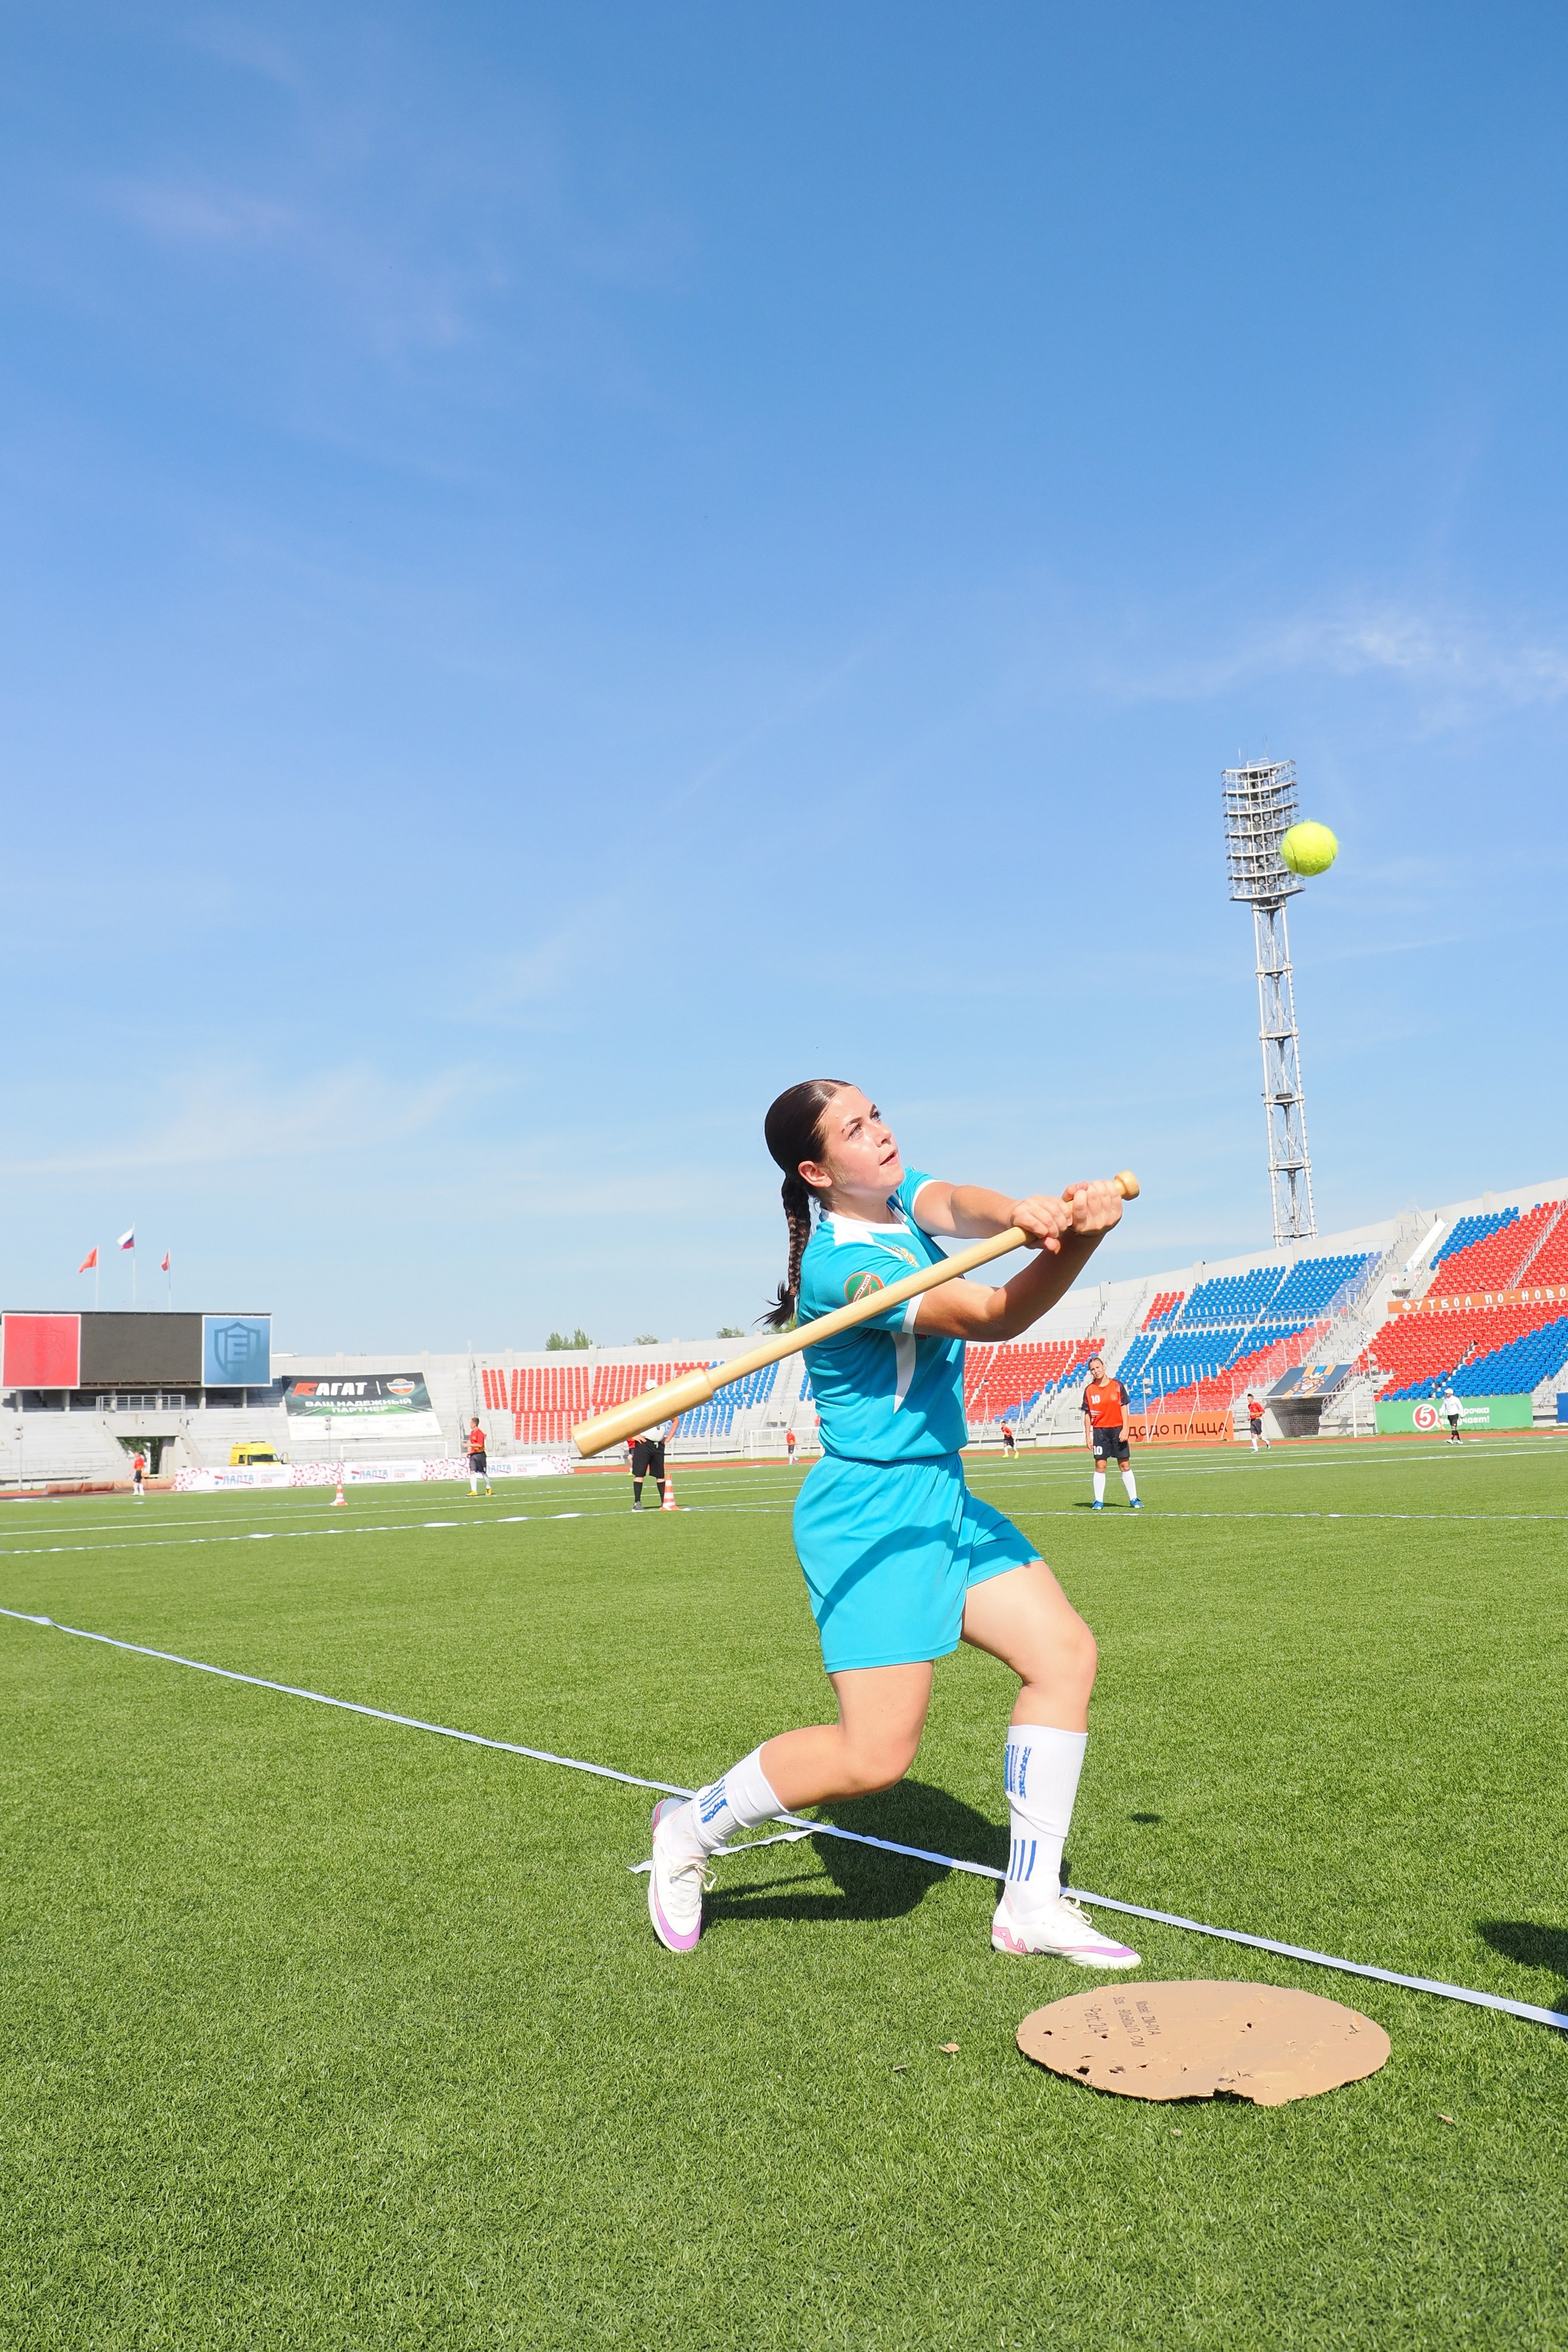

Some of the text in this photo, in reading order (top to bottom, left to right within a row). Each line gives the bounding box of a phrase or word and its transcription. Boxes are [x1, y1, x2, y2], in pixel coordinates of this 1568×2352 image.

[1401, 1295, 1472, 1311] ФУТБОЛ
[315, 1382, 368, 1396] АГАТ
[336, 1398, 412, 1406] НАДЕЖНЫЙ
[1091, 1395, 1101, 1404] 10
[1419, 1406, 1433, 1427] 5
[1128, 1422, 1228, 1439] ДОДО ПИЦЦА
[1093, 1446, 1103, 1455] 10
[222, 1474, 254, 1485] ЛАПТА
[359, 1469, 388, 1480] ЛАПТА
